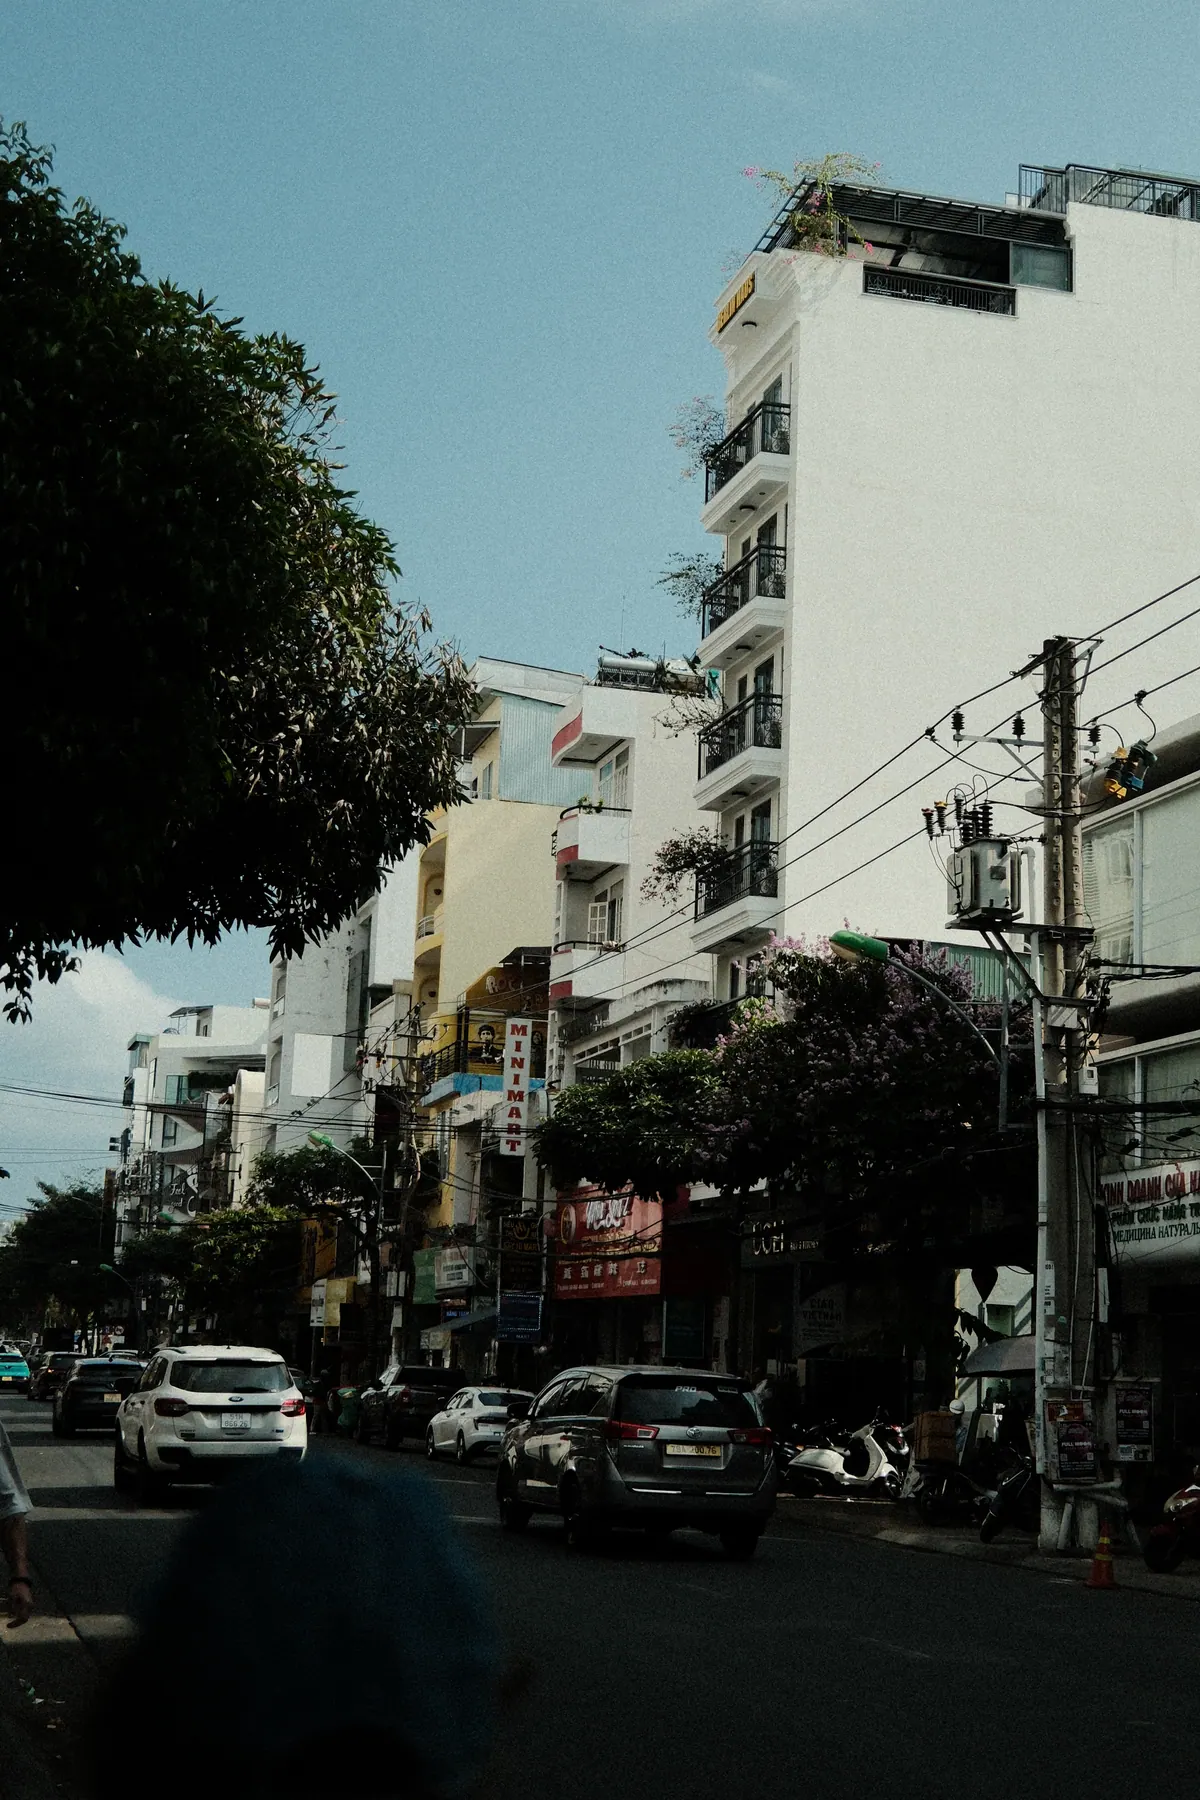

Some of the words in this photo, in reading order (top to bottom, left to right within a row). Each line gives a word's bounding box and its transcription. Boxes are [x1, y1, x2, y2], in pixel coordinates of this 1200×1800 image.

[505, 1023, 528, 1152] MINIMART
[170, 1182, 186, 1196] Feel
[1127, 1175, 1162, 1203] DOANH
[1114, 1226, 1157, 1243] МЕДИЦИНА
